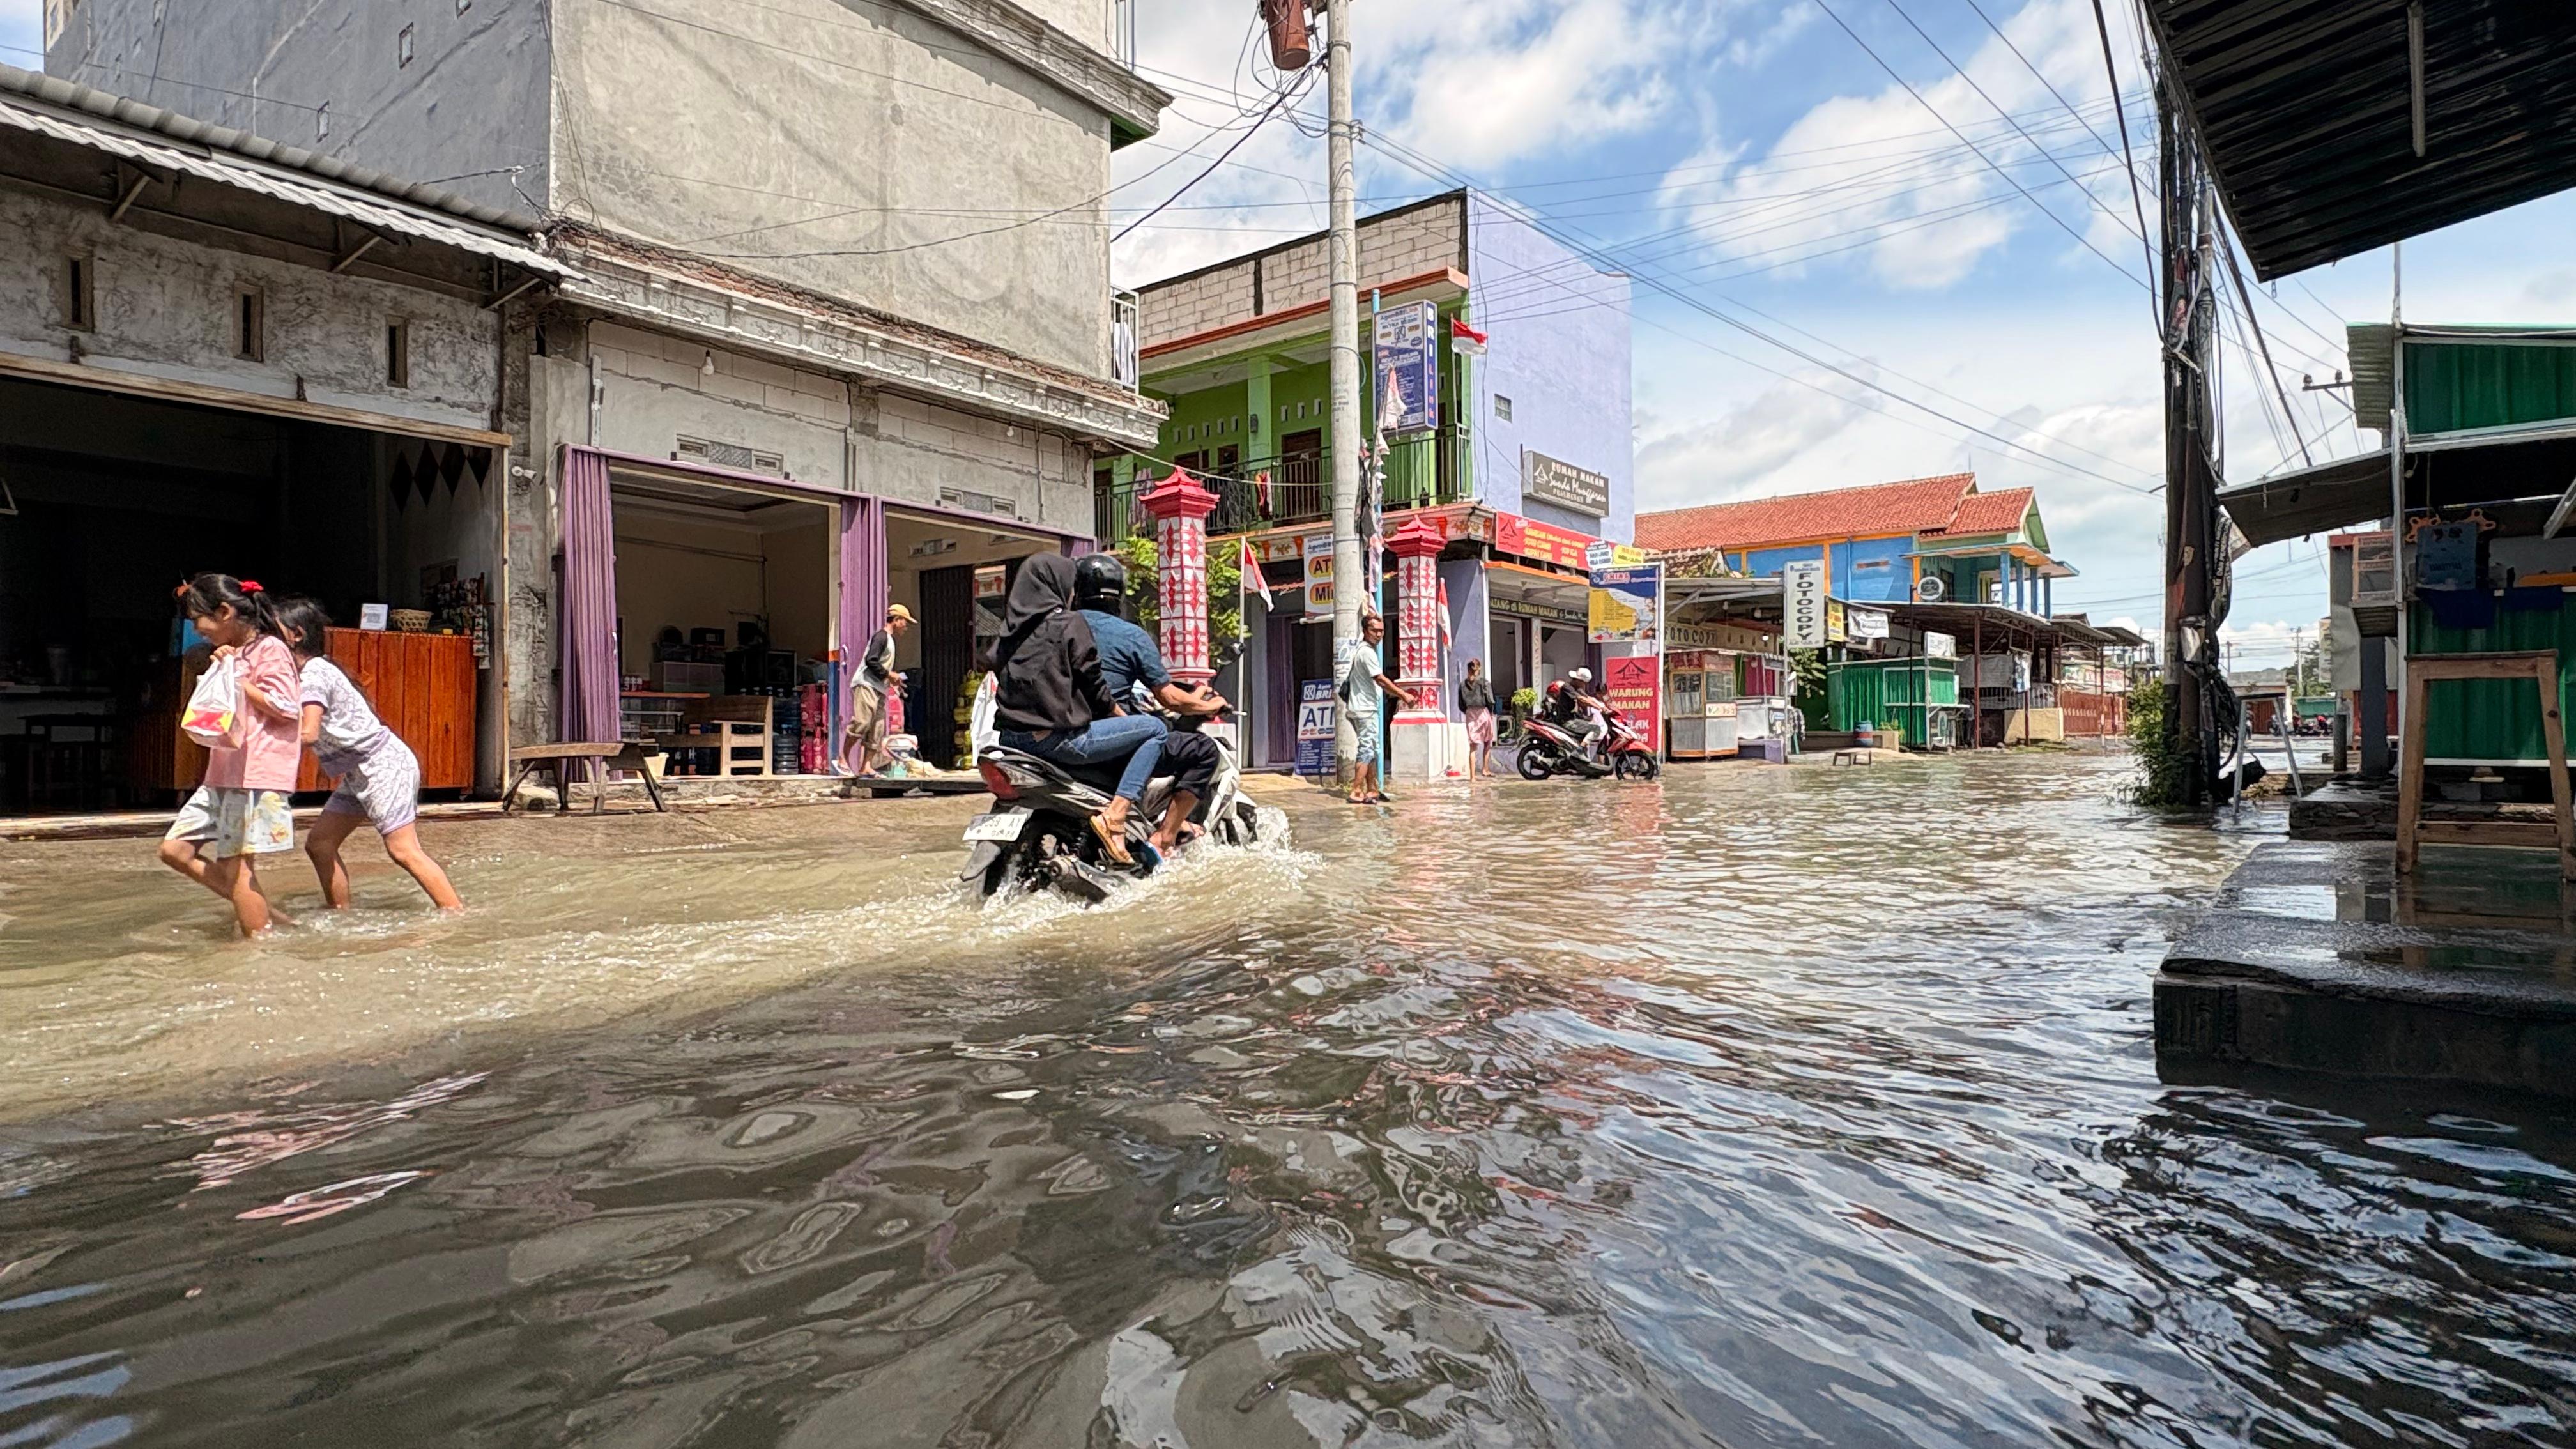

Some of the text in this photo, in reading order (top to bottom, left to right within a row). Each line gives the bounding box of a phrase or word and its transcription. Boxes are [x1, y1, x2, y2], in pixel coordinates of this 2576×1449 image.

[1551, 461, 1605, 488] RUMAH MAKAN
[1313, 558, 1334, 575] AT
[1797, 572, 1814, 640] FOTOCOPY
[1609, 687, 1653, 698] WARUNG
[1613, 700, 1650, 710] MAKAN
